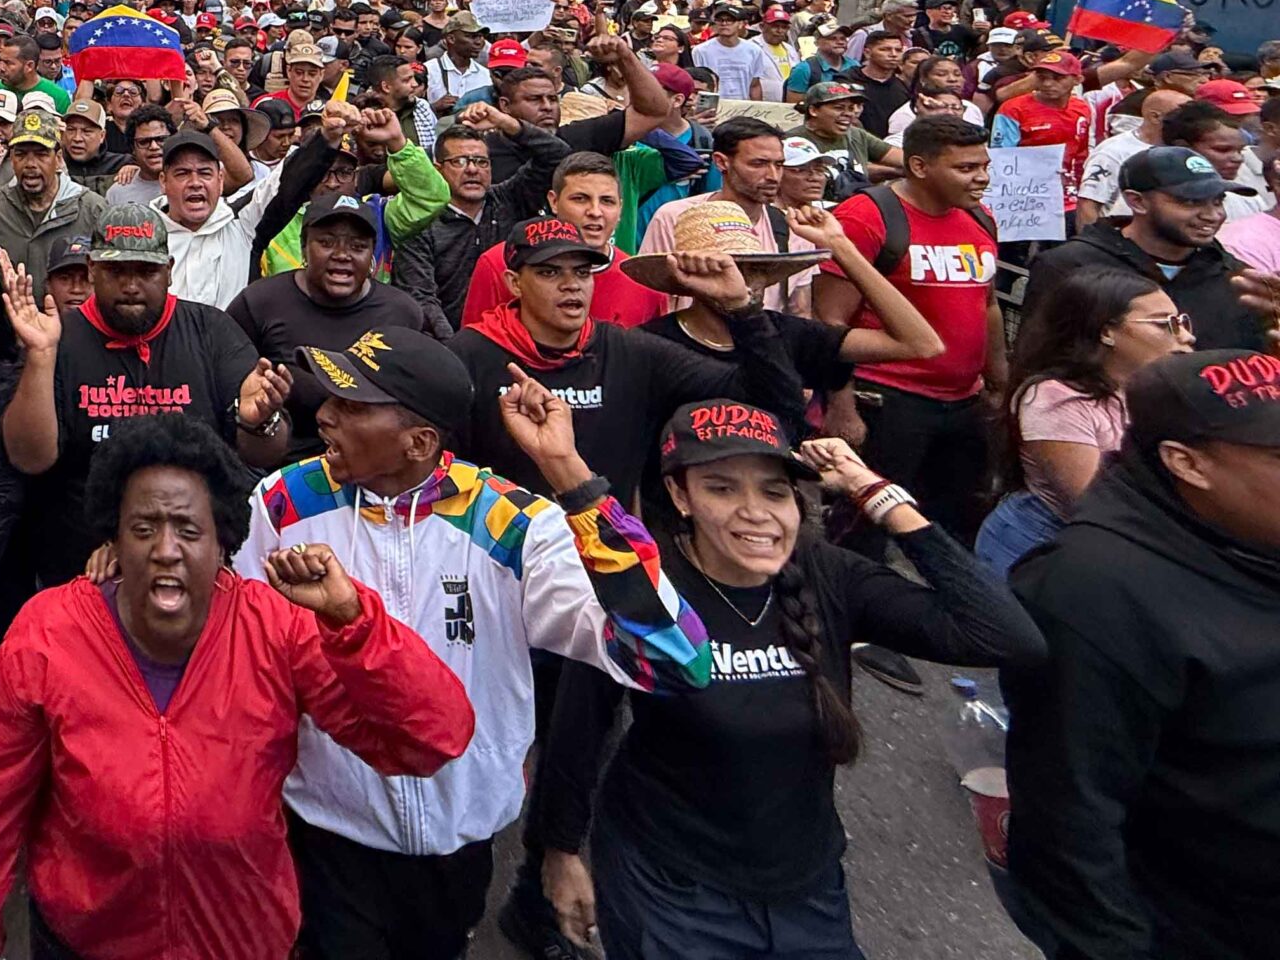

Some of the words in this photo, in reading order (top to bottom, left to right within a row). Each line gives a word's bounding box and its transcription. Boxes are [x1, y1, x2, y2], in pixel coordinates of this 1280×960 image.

[690, 405, 778, 432] DUDAR
[696, 426, 713, 441] ES
[715, 425, 780, 448] TRAICION
